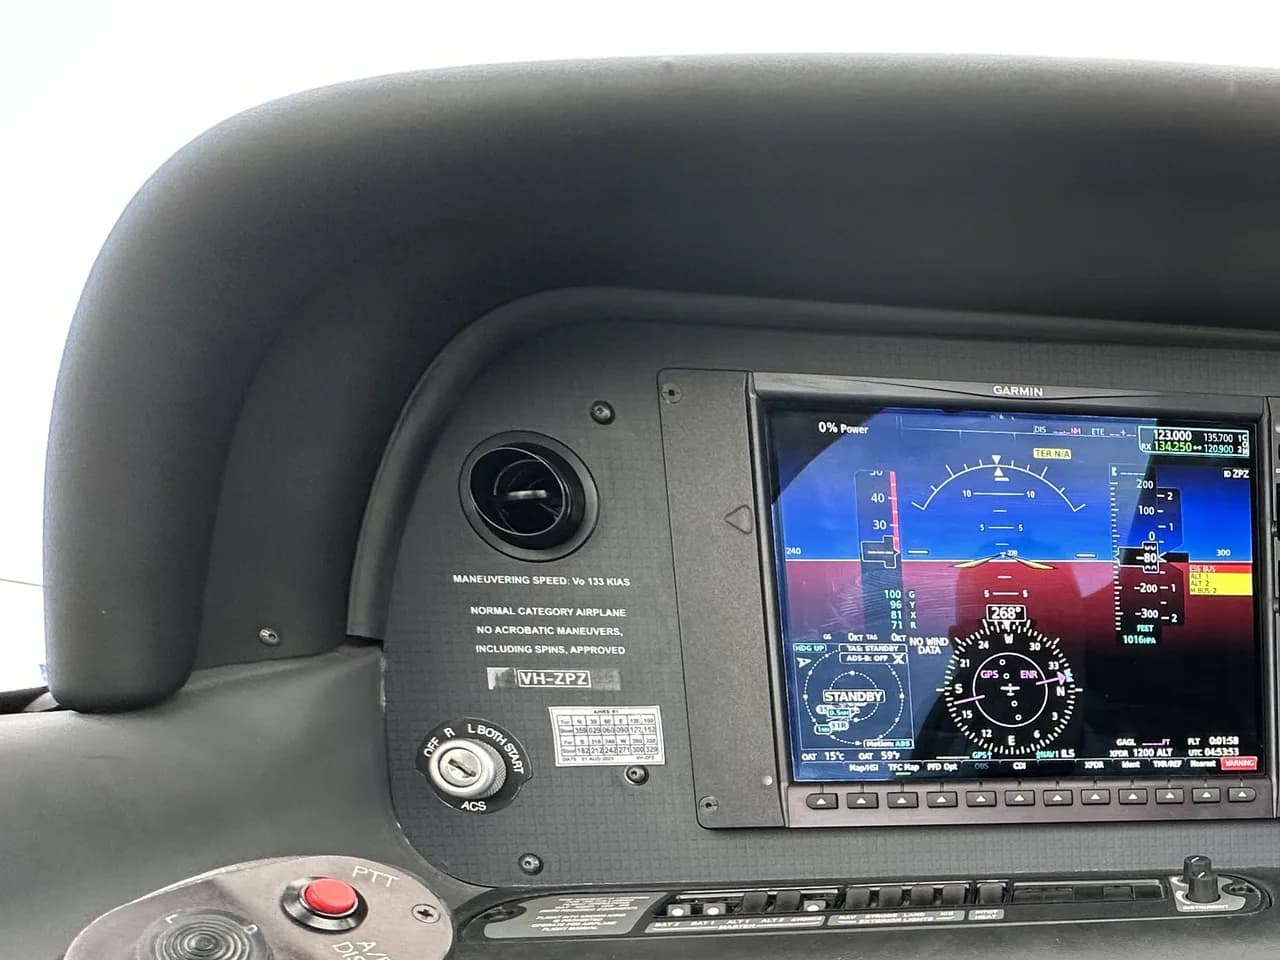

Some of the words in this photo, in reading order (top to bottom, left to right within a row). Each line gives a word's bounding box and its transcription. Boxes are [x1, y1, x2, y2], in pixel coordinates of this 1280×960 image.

[993, 386, 1043, 396] GARMIN
[818, 422, 838, 433] 0%
[840, 424, 868, 434] Power
[1154, 430, 1192, 440] 123.000
[1204, 433, 1233, 442] 135.700
[1233, 470, 1249, 478] ZPZ
[1137, 480, 1153, 488] 200
[1138, 506, 1154, 514] 100
[453, 575, 530, 586] MANEUVERING
[532, 576, 570, 586] SPEED:
[573, 577, 585, 586] Vo
[588, 577, 604, 586] 133
[606, 578, 630, 586] KIAS
[471, 606, 515, 616] NORMAL
[517, 607, 573, 617] CATEGORY
[576, 607, 626, 617] AIRPLANE
[992, 607, 1021, 619] 268°
[477, 626, 493, 635] NO
[495, 626, 553, 636] ACROBATIC
[556, 626, 623, 637] MANEUVERS,
[909, 637, 922, 646] NO
[924, 638, 948, 646] WIND
[476, 645, 532, 654] INCLUDING
[535, 645, 567, 656] SPINS,
[570, 645, 625, 655] APPROVED
[918, 646, 941, 654] DATA
[520, 672, 588, 686] VH-ZPZ
[981, 671, 998, 679] GPS
[1020, 670, 1038, 679] ENR
[825, 692, 882, 701] STANDBY
[477, 724, 505, 746] BOTH
[424, 737, 440, 757] OFF
[504, 742, 524, 774] START
[461, 801, 487, 812] ACS
[352, 866, 400, 888] PTT
